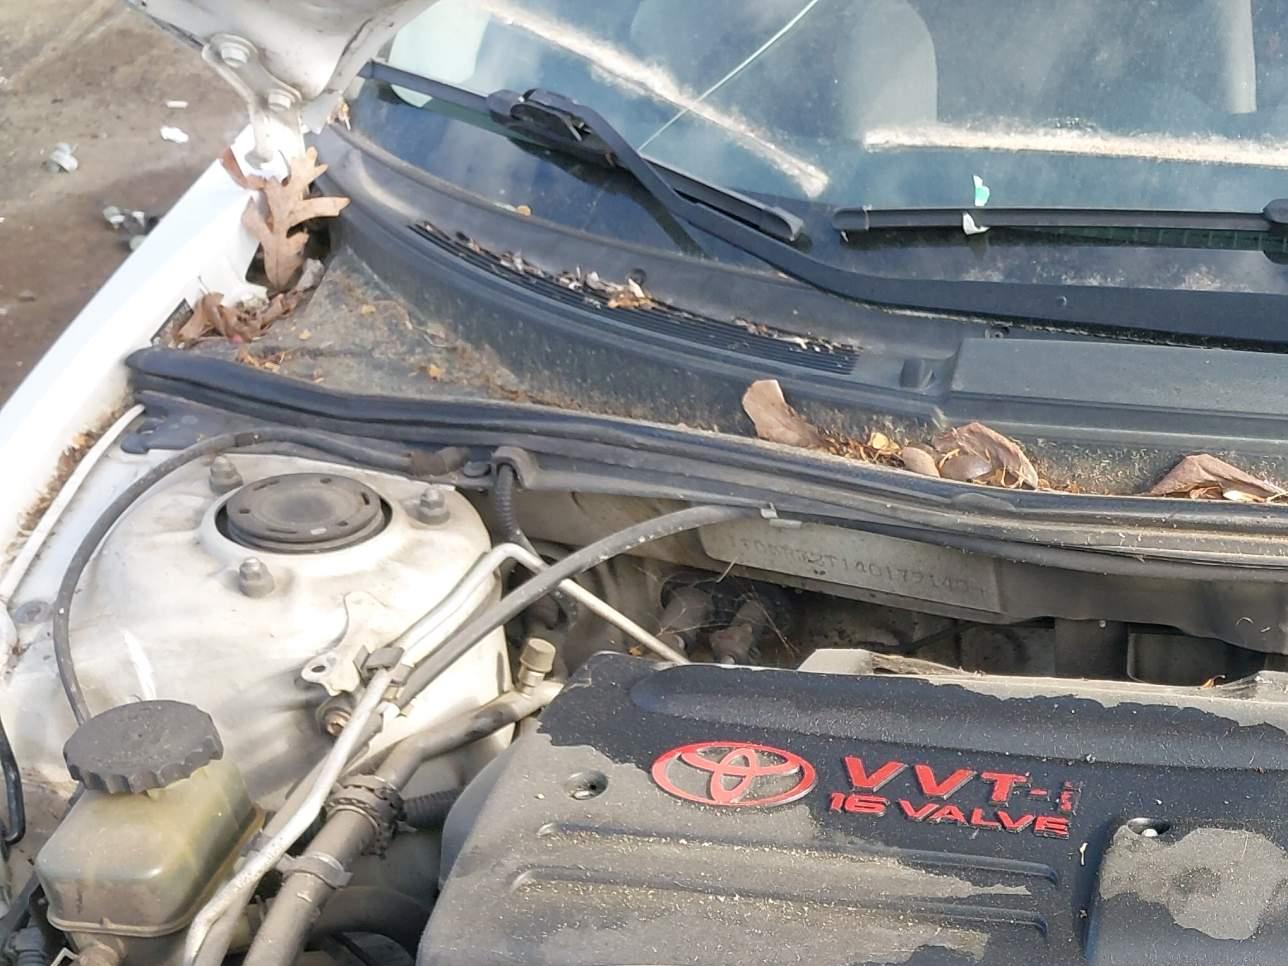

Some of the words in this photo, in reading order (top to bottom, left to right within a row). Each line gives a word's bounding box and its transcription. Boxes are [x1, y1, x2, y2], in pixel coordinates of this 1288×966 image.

[845, 755, 1081, 816] VVT-i
[828, 792, 889, 816] 16
[899, 801, 1070, 839] VALVE
